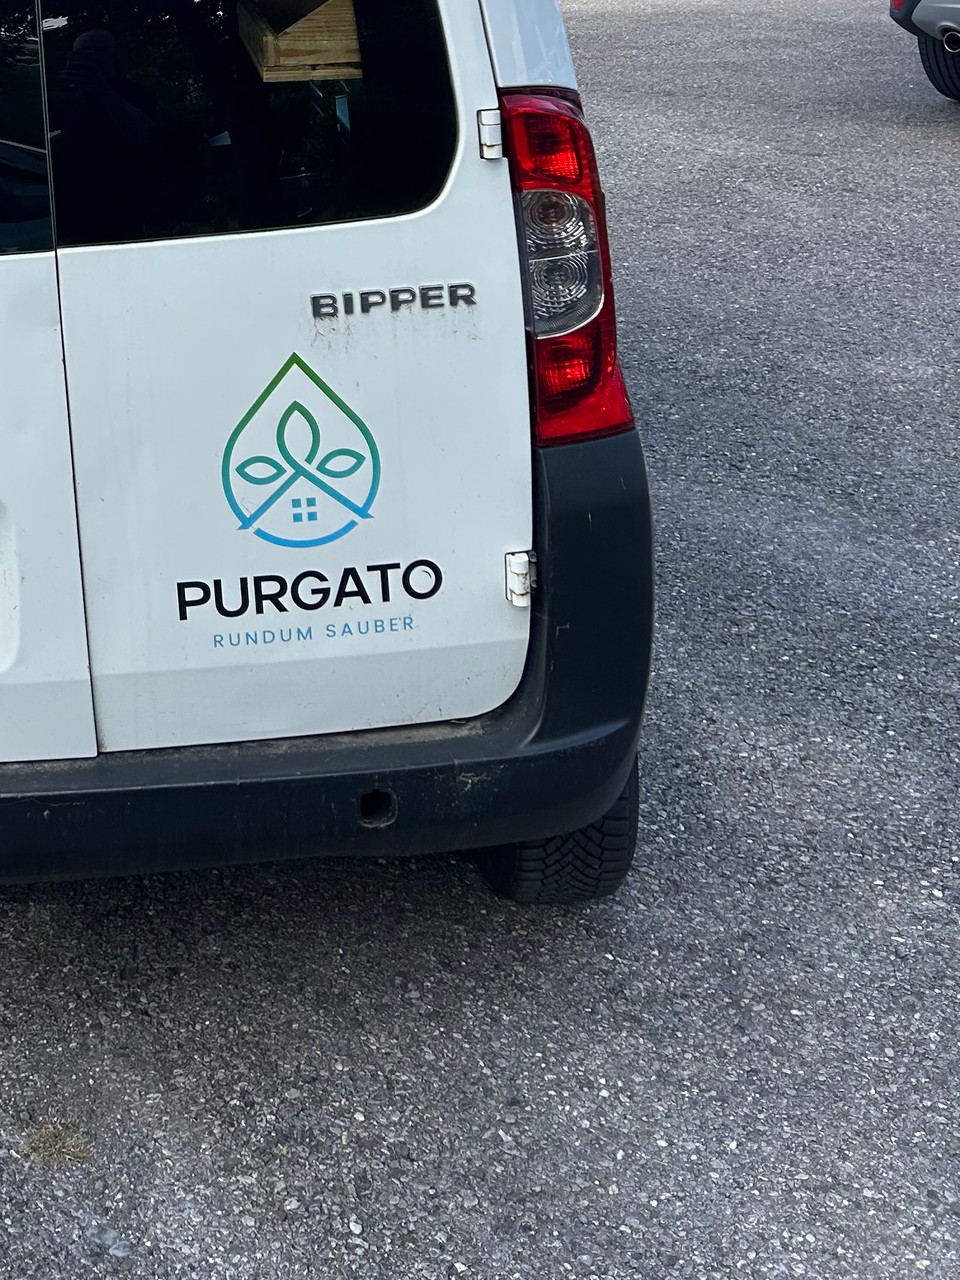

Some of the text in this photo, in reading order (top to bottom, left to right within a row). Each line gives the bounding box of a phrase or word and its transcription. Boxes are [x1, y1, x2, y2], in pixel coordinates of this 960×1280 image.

[310, 281, 477, 319] BIPPER
[176, 558, 443, 621] PURGATO
[213, 616, 415, 648] RUNDUM SAUBER
